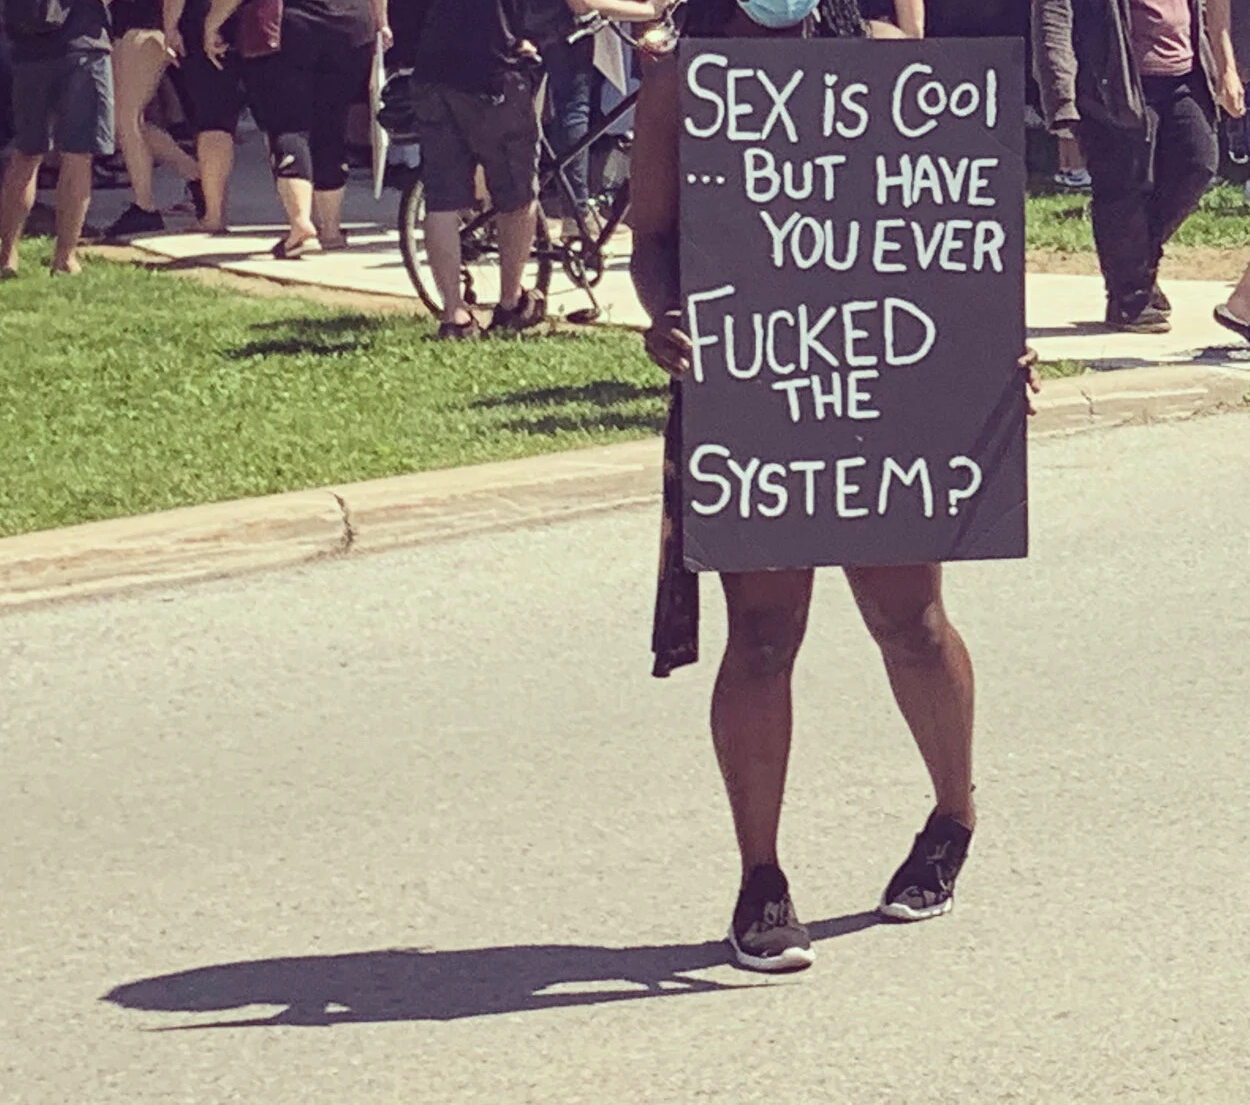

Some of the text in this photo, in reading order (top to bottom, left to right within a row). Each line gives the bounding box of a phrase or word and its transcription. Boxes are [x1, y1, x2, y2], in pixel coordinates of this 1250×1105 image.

[684, 53, 804, 143] SEX
[743, 147, 847, 203] BUT
[875, 152, 999, 208] HAVE
[759, 210, 1006, 273] YOU EVER
[686, 284, 937, 383] FUCKED
[771, 369, 881, 423] THE
